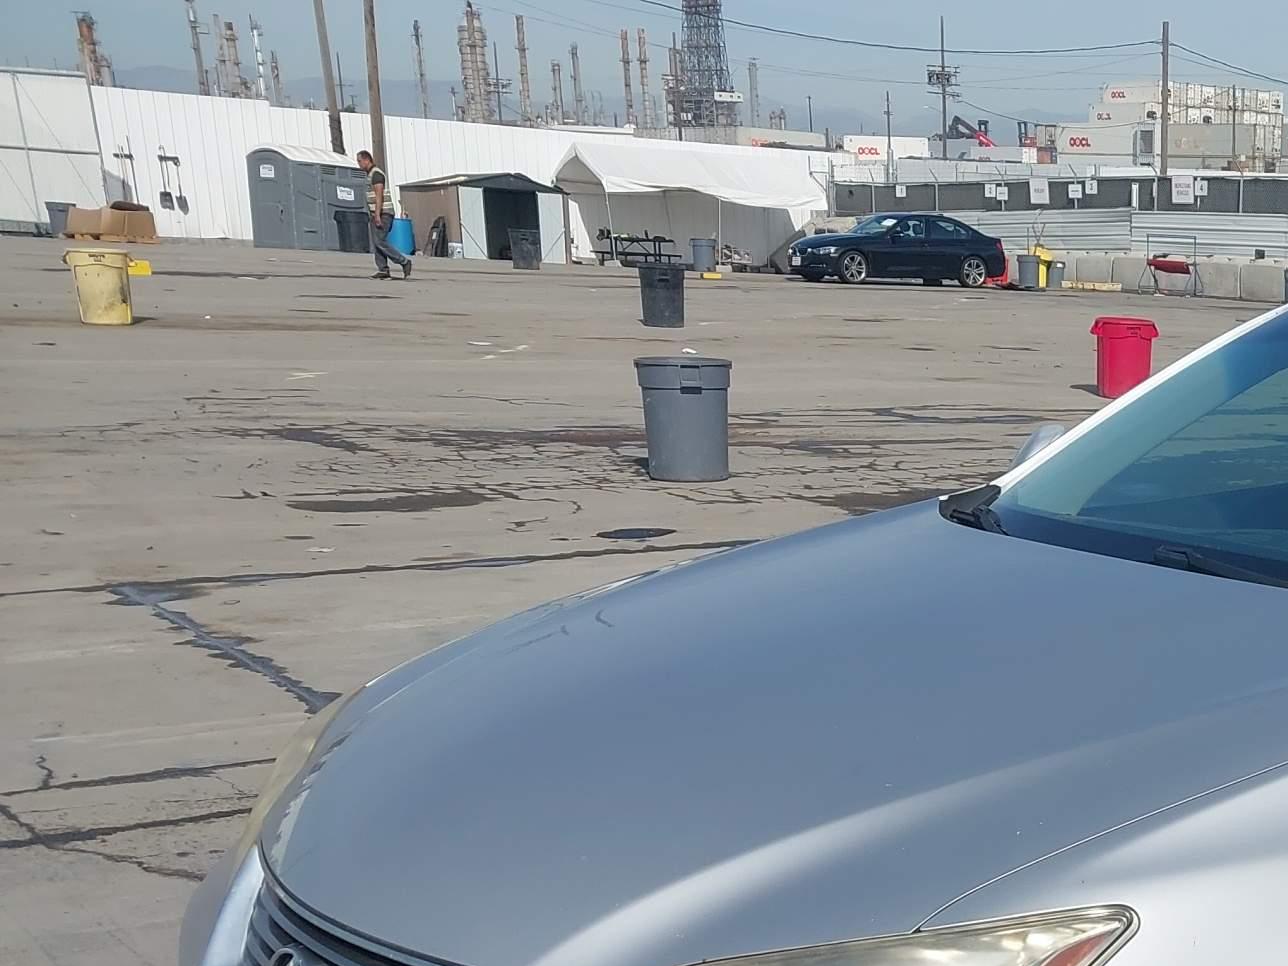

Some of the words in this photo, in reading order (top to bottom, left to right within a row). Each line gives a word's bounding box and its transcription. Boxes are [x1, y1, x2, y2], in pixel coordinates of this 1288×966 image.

[1110, 90, 1126, 99] OOCL
[1069, 136, 1091, 148] OOCL
[857, 146, 880, 156] OOCL
